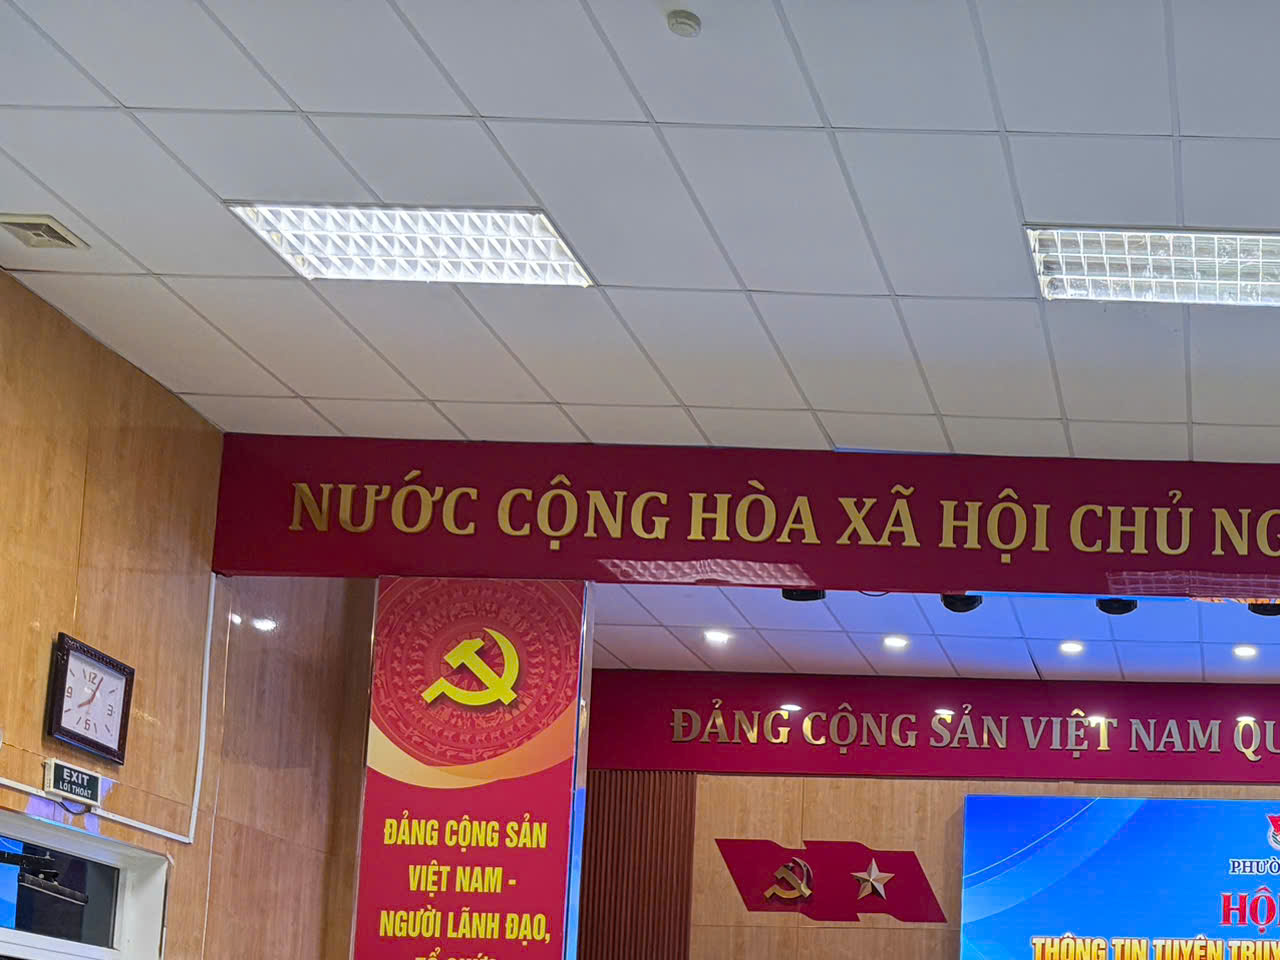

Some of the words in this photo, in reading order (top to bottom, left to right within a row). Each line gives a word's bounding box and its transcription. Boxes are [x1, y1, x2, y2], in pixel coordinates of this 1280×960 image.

[288, 470, 478, 535] NƯỚC
[498, 475, 670, 551] CỘNG
[688, 480, 822, 546] HÒA
[837, 486, 920, 548] XÃ
[939, 489, 1050, 563] HỘI
[1069, 489, 1192, 556] CHỦ
[670, 699, 791, 744] ĐẢNG
[802, 703, 917, 754] CỘNG
[929, 703, 1008, 750] SẢN
[1020, 708, 1117, 758] VIỆT
[1129, 718, 1221, 752] NAM
[63, 768, 89, 786] EXIT
[384, 810, 438, 846] ĐẢNG
[445, 815, 499, 852] CỘNG
[505, 813, 547, 848] SẢN
[408, 860, 450, 897] VIỆT
[456, 866, 503, 893] NAM
[379, 905, 441, 938] NGƯỜI
[447, 907, 500, 939] LÃNH
[505, 914, 550, 946] ĐẠO,
